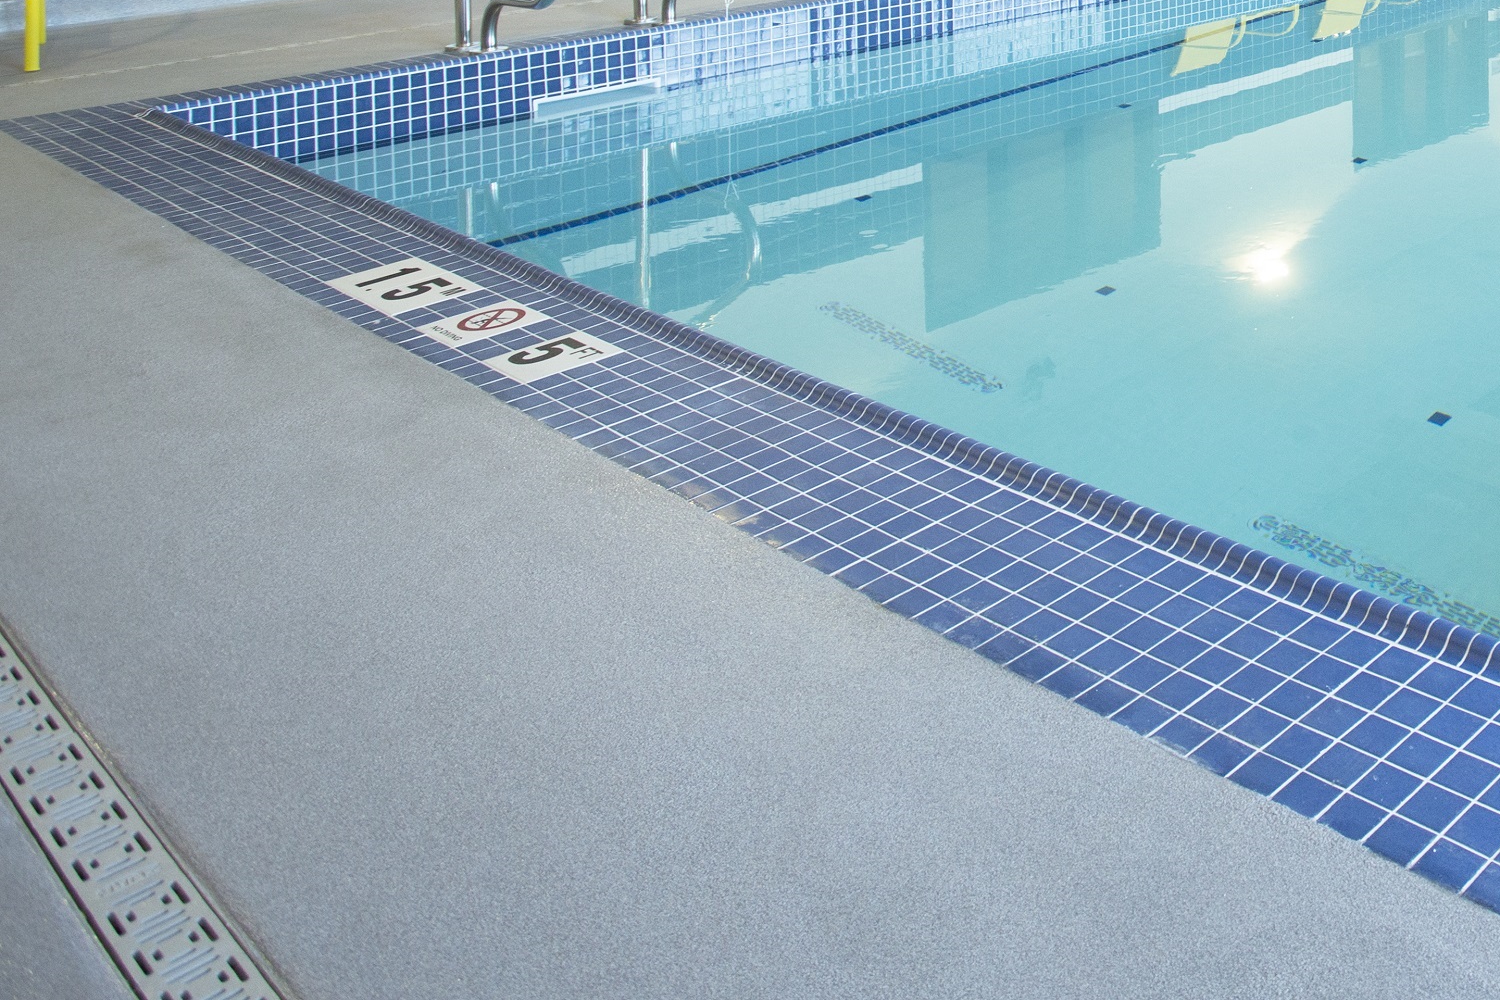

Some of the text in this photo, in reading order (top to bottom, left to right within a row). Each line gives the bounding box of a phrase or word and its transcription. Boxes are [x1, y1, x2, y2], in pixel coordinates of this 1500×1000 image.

[355, 267, 467, 300] 1.5 M
[508, 337, 604, 364] 5 FT
